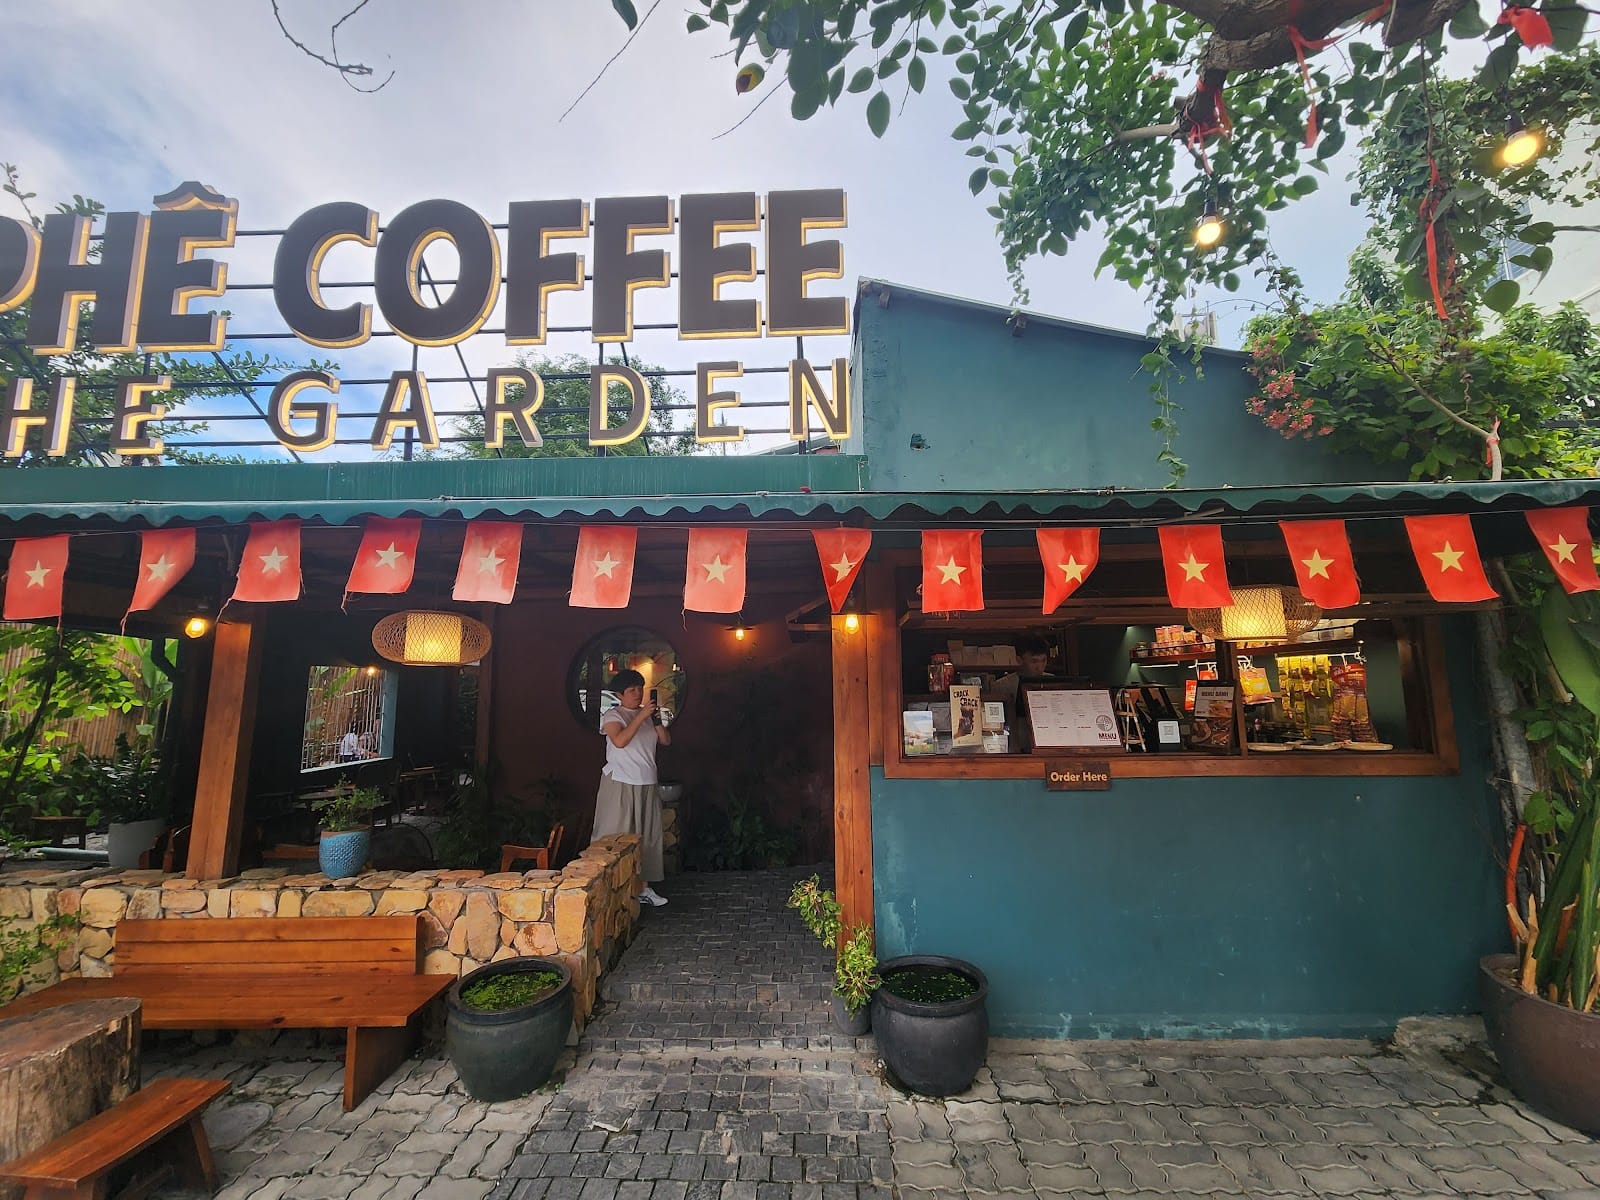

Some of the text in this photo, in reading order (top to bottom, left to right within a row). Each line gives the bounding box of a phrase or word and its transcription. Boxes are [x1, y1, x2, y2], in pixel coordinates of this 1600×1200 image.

[273, 189, 850, 348] COFFEE
[267, 358, 851, 453] GARDEN
[960, 698, 978, 707] CRACK
[1050, 771, 1108, 782] Order Here
